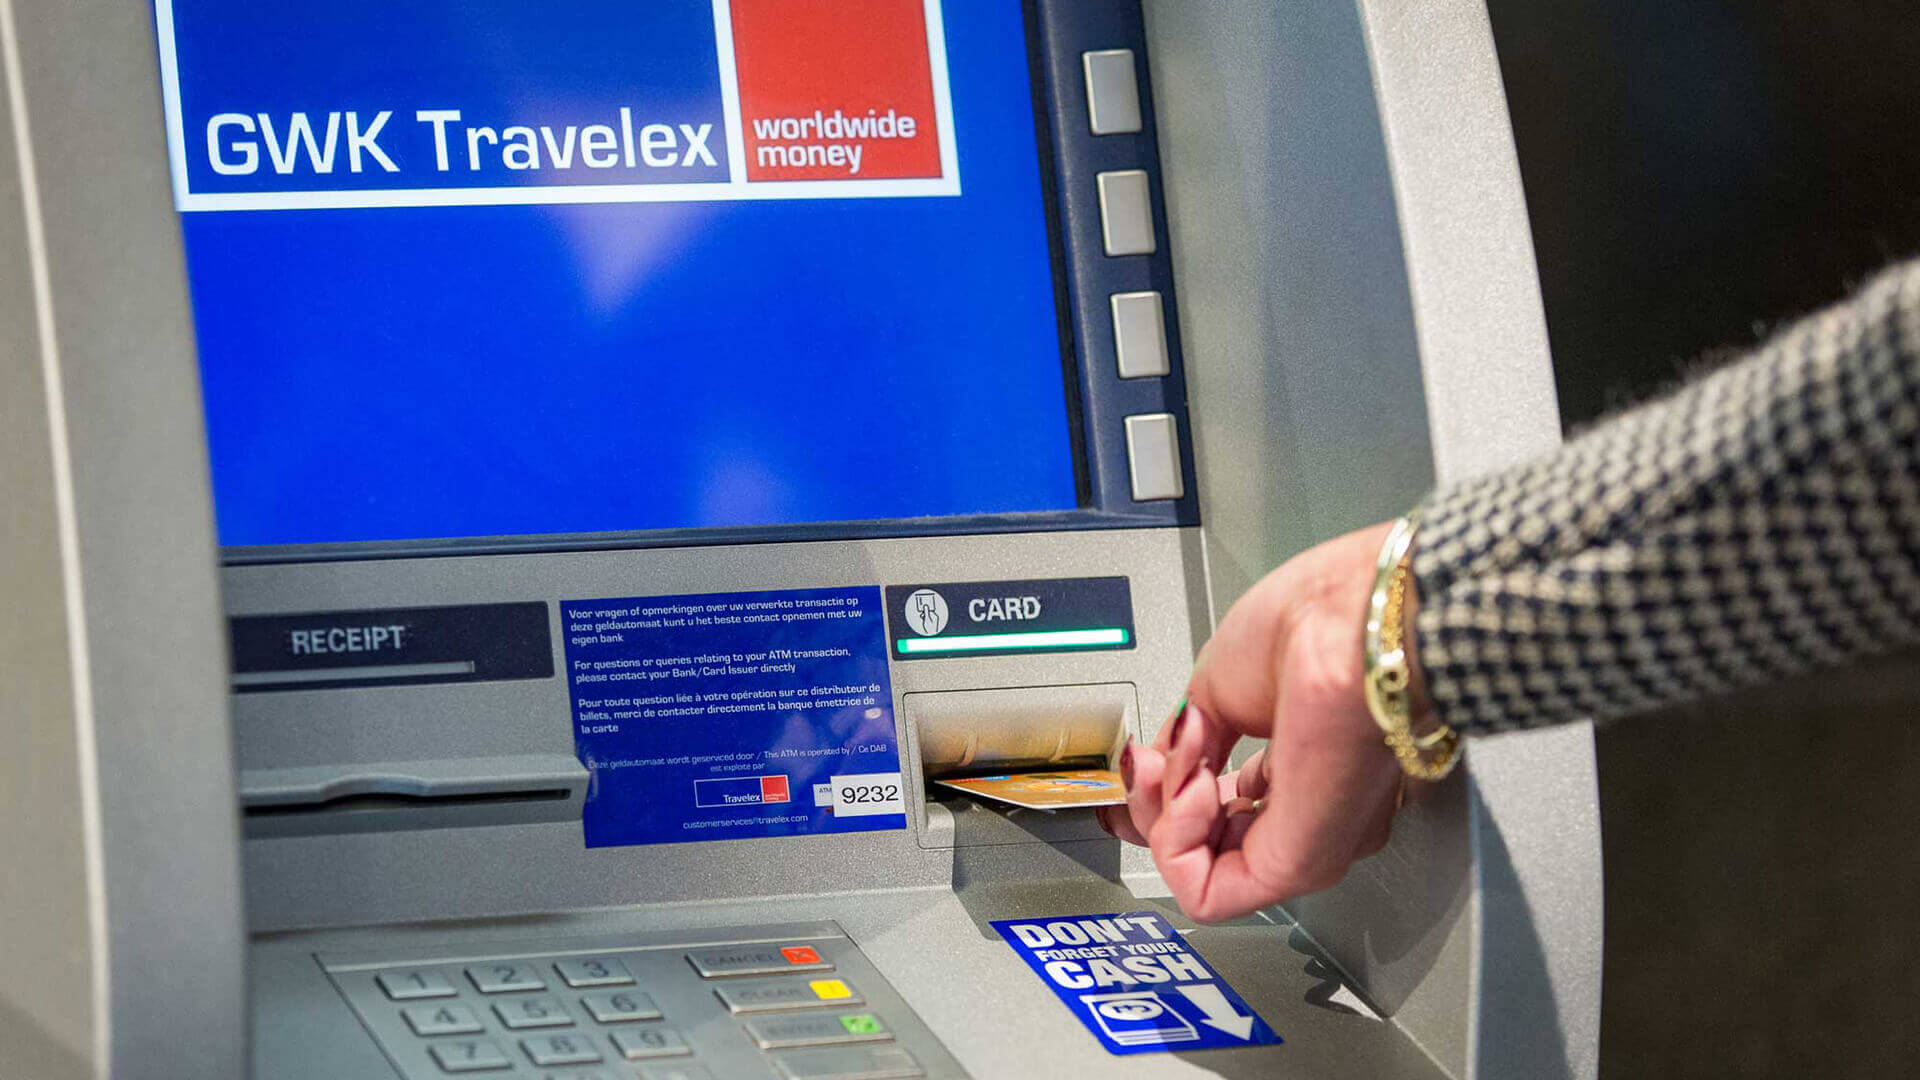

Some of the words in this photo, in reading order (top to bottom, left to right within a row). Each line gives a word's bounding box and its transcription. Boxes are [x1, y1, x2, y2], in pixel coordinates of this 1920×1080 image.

[753, 109, 916, 140] worldwide
[207, 111, 400, 175] GWK
[416, 107, 718, 171] Travelex
[757, 144, 862, 173] money
[569, 609, 592, 619] Voor
[595, 608, 628, 619] vragen
[630, 606, 640, 616] of
[642, 604, 704, 617] opmerkingen
[706, 603, 727, 612] over
[730, 603, 743, 611] uw
[745, 600, 793, 610] verwerkte
[796, 597, 844, 607] transactie
[846, 597, 858, 607] op
[968, 595, 1042, 622] CARD
[571, 622, 592, 631] deze
[595, 619, 661, 632] geldautomaat
[664, 618, 685, 627] kunt
[687, 618, 693, 626] u
[696, 616, 712, 625] het
[715, 615, 741, 624] beste
[743, 613, 780, 623] contact
[782, 612, 825, 622] opnemen
[827, 610, 846, 619] met
[848, 609, 862, 618] uw
[290, 625, 405, 654] RECEIPT
[572, 634, 598, 647] eigen
[601, 633, 624, 643] bank
[575, 660, 591, 670] For
[594, 658, 640, 671] questions
[642, 658, 653, 667] or
[656, 655, 692, 667] queries
[694, 654, 730, 665] relating
[733, 653, 743, 662] to
[745, 653, 767, 663] your
[768, 650, 791, 660] ATM
[794, 647, 851, 658] transaction,
[576, 673, 607, 685] please
[610, 671, 647, 681] contact
[649, 670, 670, 681] your
[672, 666, 726, 678] Bank/Card
[728, 665, 758, 675] Issuer
[761, 663, 796, 673] directly
[578, 698, 602, 708] Pour
[604, 697, 631, 707] toute
[633, 694, 674, 707] question
[676, 693, 693, 703] liée
[695, 691, 701, 701] à
[703, 692, 728, 701] votre
[731, 688, 777, 700] opération
[779, 688, 795, 697] sur
[797, 688, 809, 696] ce
[810, 685, 867, 695] distributeur
[869, 683, 881, 692] de
[580, 710, 612, 721] billets,
[614, 709, 642, 719] merci
[644, 708, 655, 718] de
[657, 706, 705, 717] contacter
[707, 703, 766, 714] directement
[767, 702, 776, 711] la
[778, 700, 813, 711] banque
[815, 697, 861, 708] émettrice
[863, 696, 875, 705] de
[581, 725, 590, 734] la
[592, 724, 618, 733] carte
[667, 755, 689, 764] wordt
[736, 752, 754, 760] door
[764, 750, 779, 759] This
[780, 749, 798, 758] ATM
[807, 747, 839, 757] operated
[841, 747, 849, 756] by
[870, 744, 886, 753] DAB
[723, 793, 760, 803] Travelex
[842, 785, 899, 804] 9232
[1009, 916, 1168, 948] DON'T
[1033, 946, 1119, 963] FORGET
[1121, 942, 1184, 956] YOUR
[409, 971, 428, 989] 1
[495, 966, 520, 983] 2
[583, 961, 610, 978] 3
[1044, 953, 1214, 989] CASH
[611, 994, 638, 1012] 6
[433, 1007, 457, 1024] 4
[462, 1042, 479, 1060] 7
